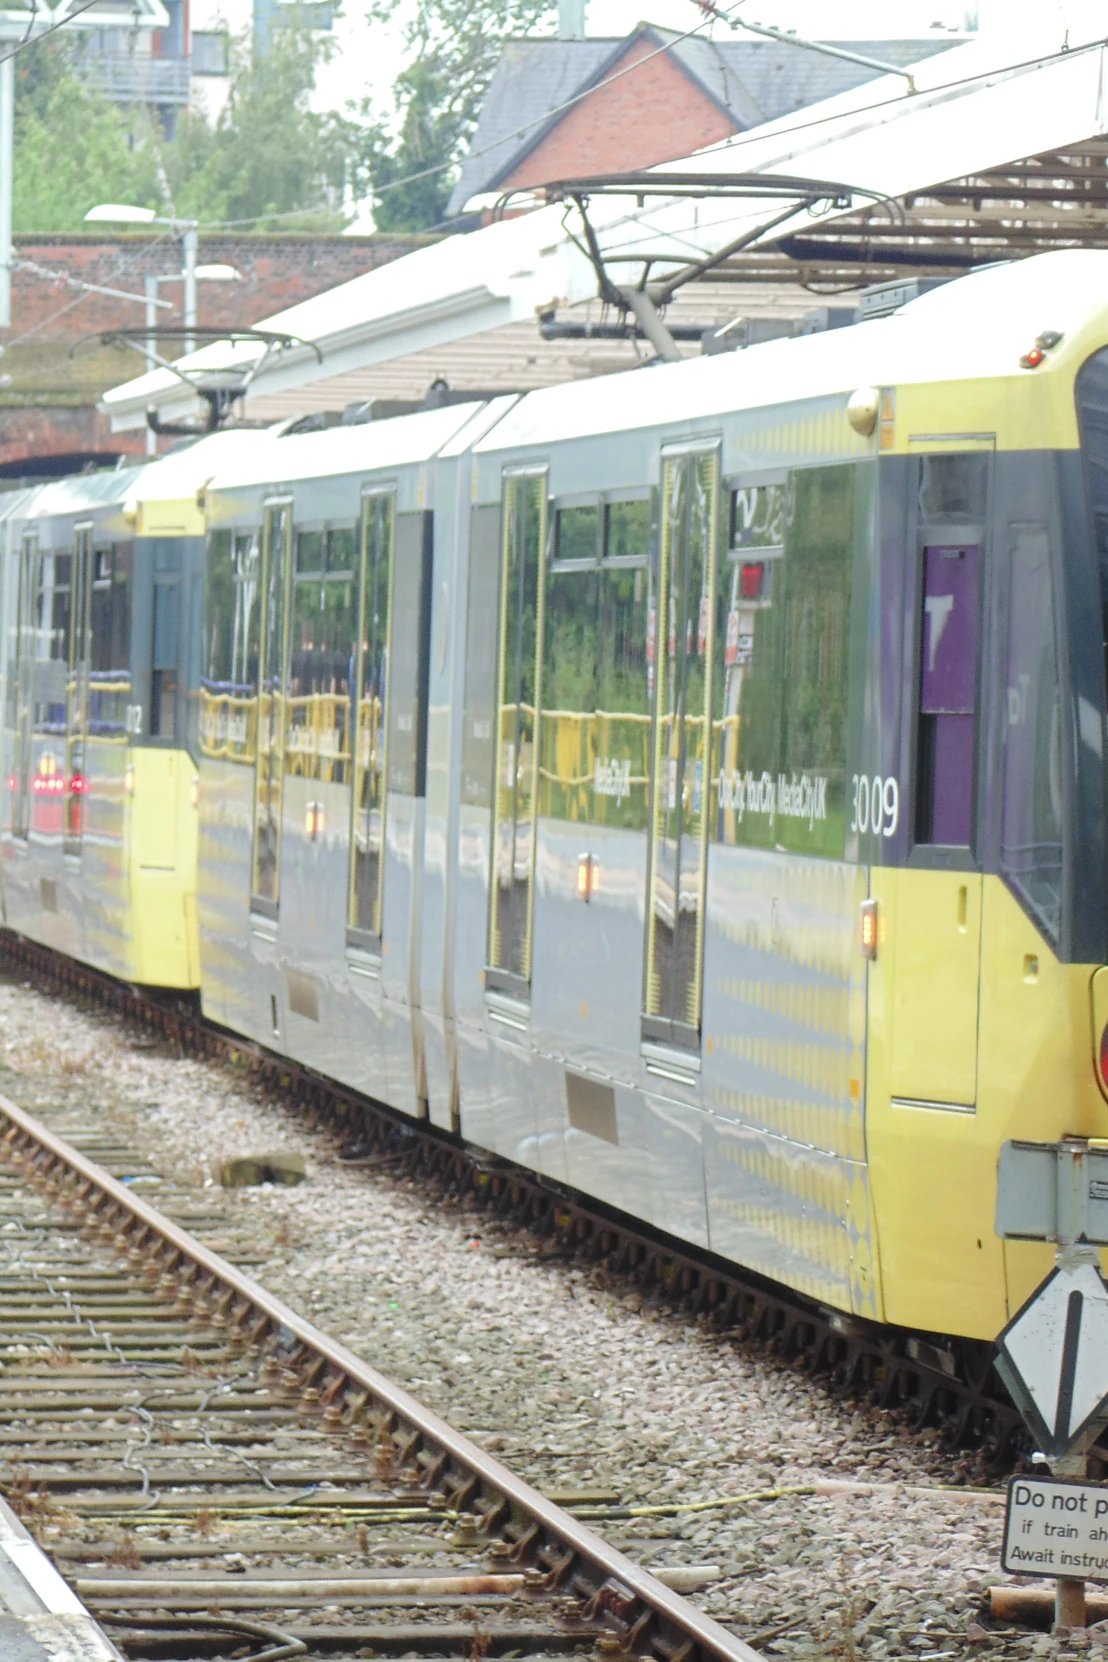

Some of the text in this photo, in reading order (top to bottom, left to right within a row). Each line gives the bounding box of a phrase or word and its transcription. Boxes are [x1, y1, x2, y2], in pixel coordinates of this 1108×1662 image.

[852, 774, 899, 837] 3009
[1015, 1486, 1045, 1508] Do
[1052, 1493, 1088, 1513] not
[1022, 1520, 1033, 1534] if
[1044, 1522, 1078, 1539] train
[1010, 1545, 1055, 1564] Await
